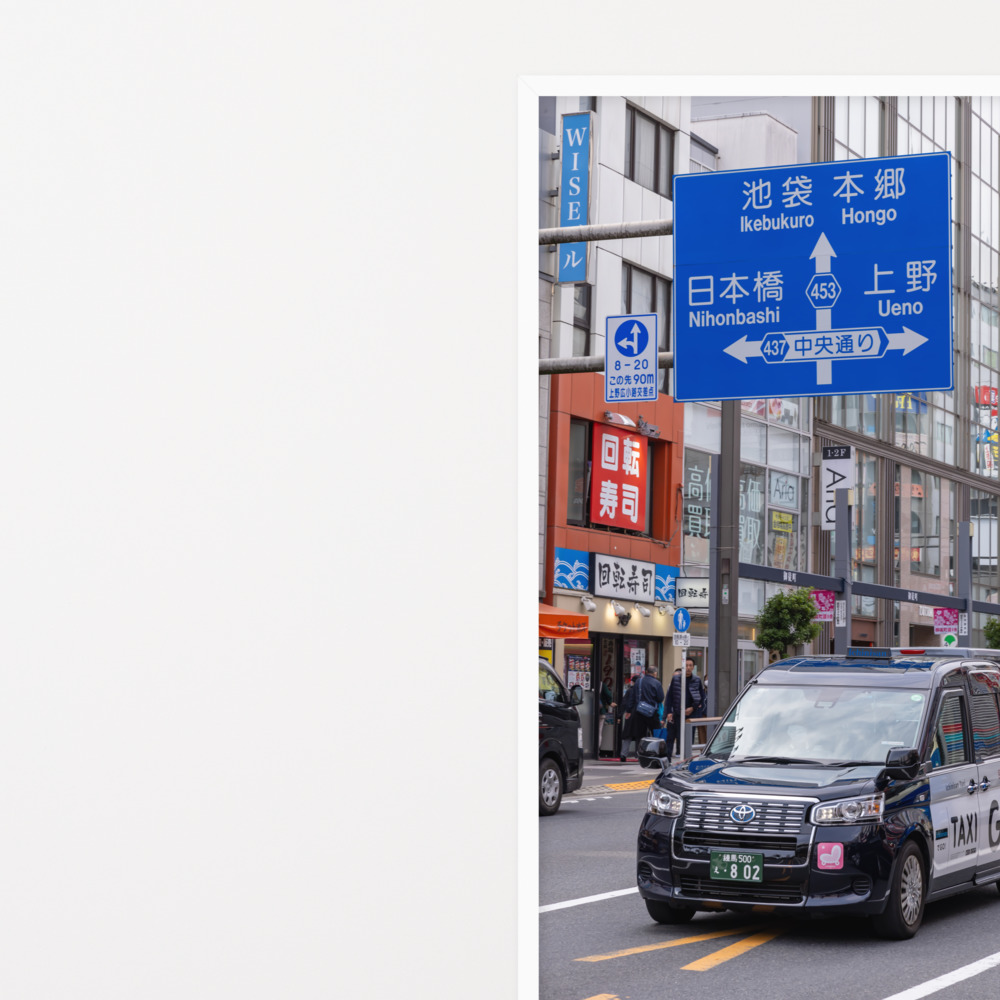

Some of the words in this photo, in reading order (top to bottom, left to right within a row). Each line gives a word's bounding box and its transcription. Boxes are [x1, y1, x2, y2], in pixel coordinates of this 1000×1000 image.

[742, 176, 813, 210] 池袋
[833, 168, 906, 203] 本郷
[740, 214, 814, 233] Ikebukuro
[841, 207, 897, 226] Hongo
[688, 270, 784, 307] 日本橋
[810, 282, 837, 300] 453
[864, 259, 938, 297] 上野
[688, 307, 780, 327] Nihonbashi
[878, 300, 923, 317] Ueno
[763, 339, 786, 356] 437
[794, 333, 875, 357] 中央通り
[601, 433, 640, 478] 回転
[600, 480, 640, 524] 寿司
[598, 562, 653, 596] 回転寿司
[950, 811, 978, 848] TAXI
[738, 854, 752, 863] 500
